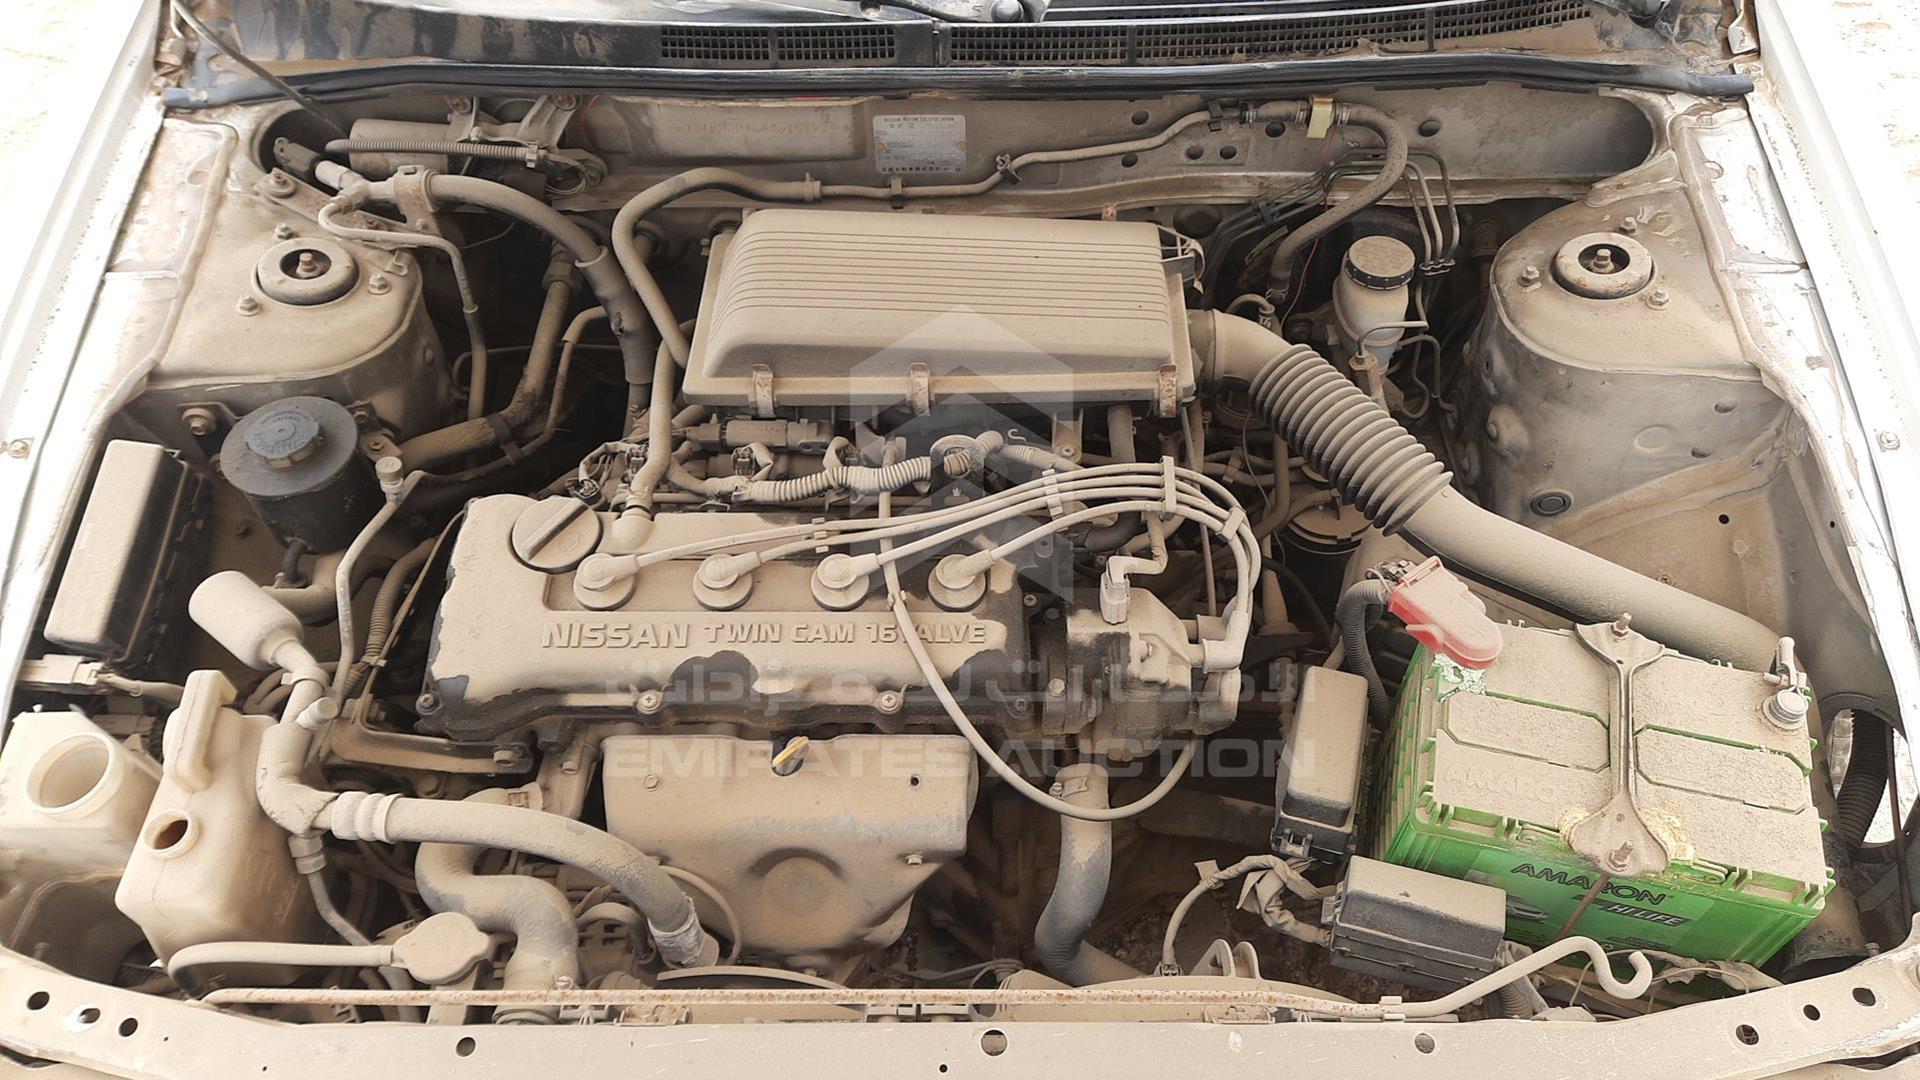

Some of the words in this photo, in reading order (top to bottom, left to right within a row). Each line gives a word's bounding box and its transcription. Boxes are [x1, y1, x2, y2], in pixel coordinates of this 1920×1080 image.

[541, 622, 690, 649] NISSAN
[704, 623, 780, 644] TWIN
[790, 623, 855, 644] CAM
[866, 623, 898, 644] 16
[1608, 904, 1635, 915] HI
[1633, 910, 1683, 926] LIFE
